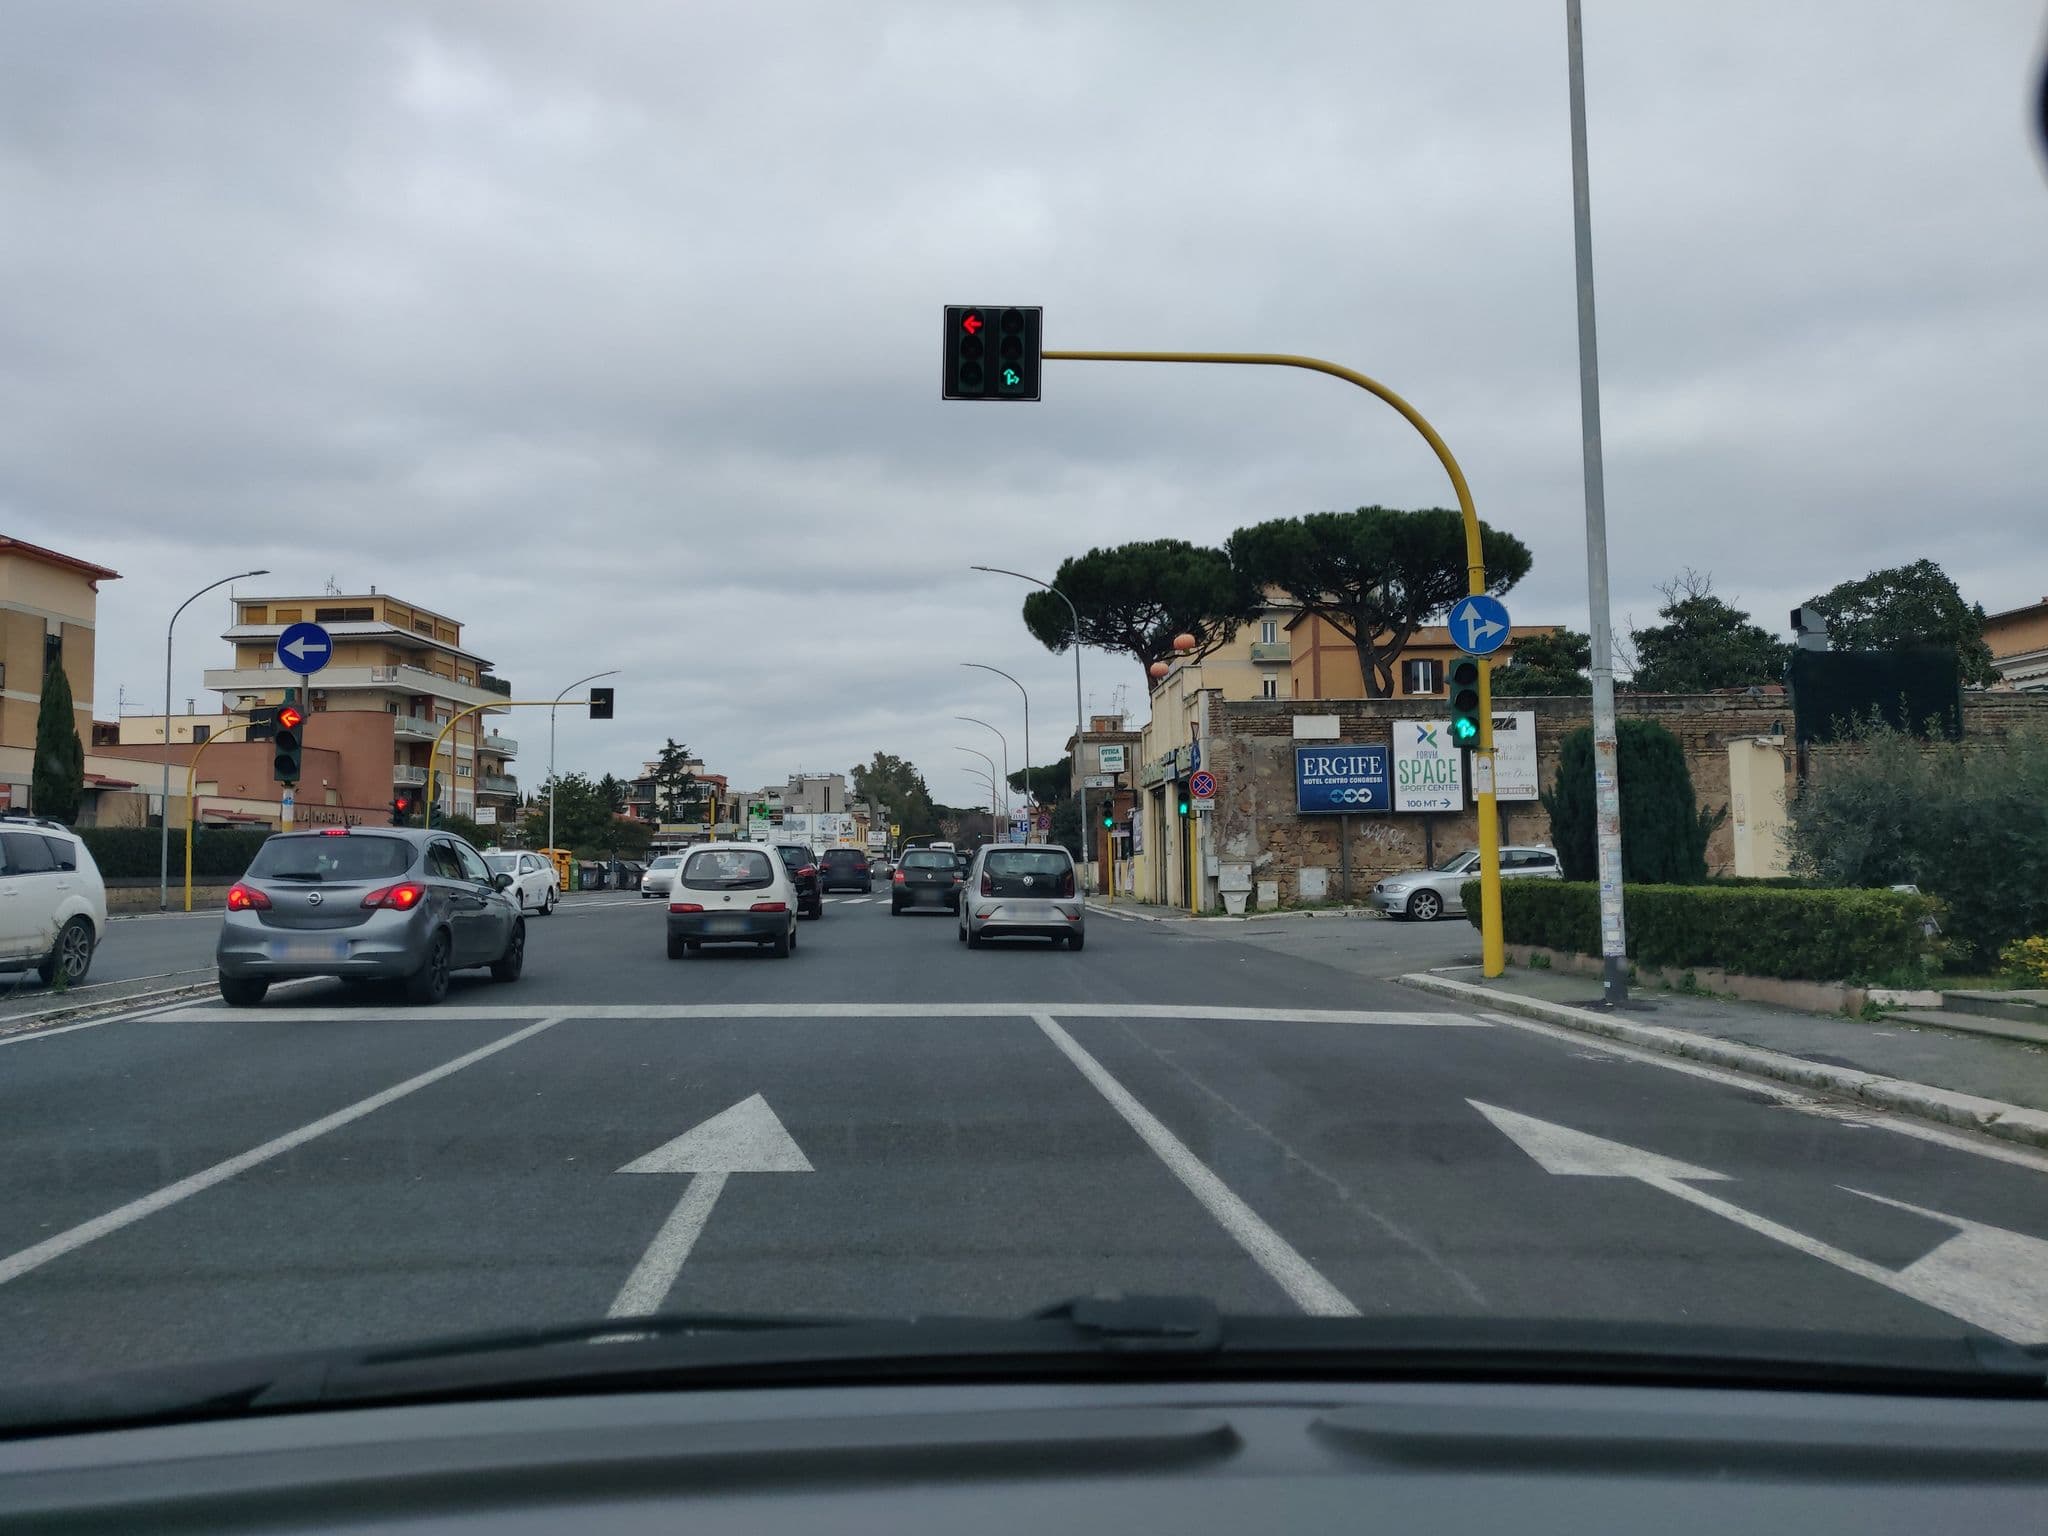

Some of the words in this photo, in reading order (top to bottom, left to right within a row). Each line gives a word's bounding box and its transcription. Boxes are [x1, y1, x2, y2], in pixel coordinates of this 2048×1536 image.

[1303, 756, 1383, 776] ERGIFE
[1399, 758, 1457, 785] SPACE
[1324, 777, 1348, 785] CENTRO
[1349, 776, 1383, 784] CONGRESSI
[1399, 784, 1427, 792] SPORT
[1427, 783, 1460, 792] CENTER
[1406, 800, 1422, 808] 100
[1423, 800, 1438, 808] MT
